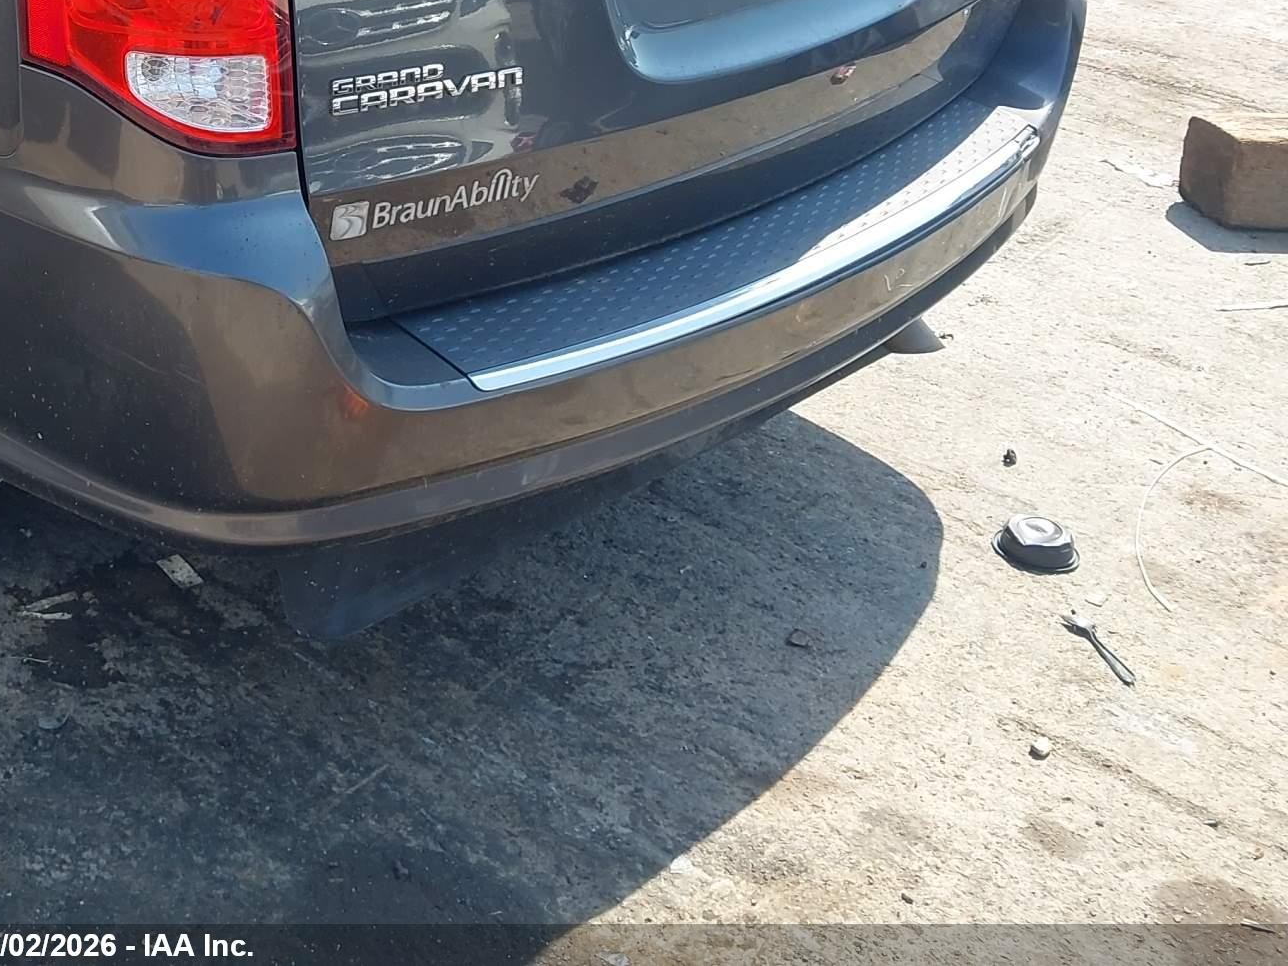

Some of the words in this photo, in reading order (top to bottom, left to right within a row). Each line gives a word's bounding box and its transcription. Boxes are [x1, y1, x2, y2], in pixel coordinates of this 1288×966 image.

[330, 66, 525, 117] CARAVAN
[331, 62, 445, 96] GRAND
[371, 168, 541, 230] BraunAbility
